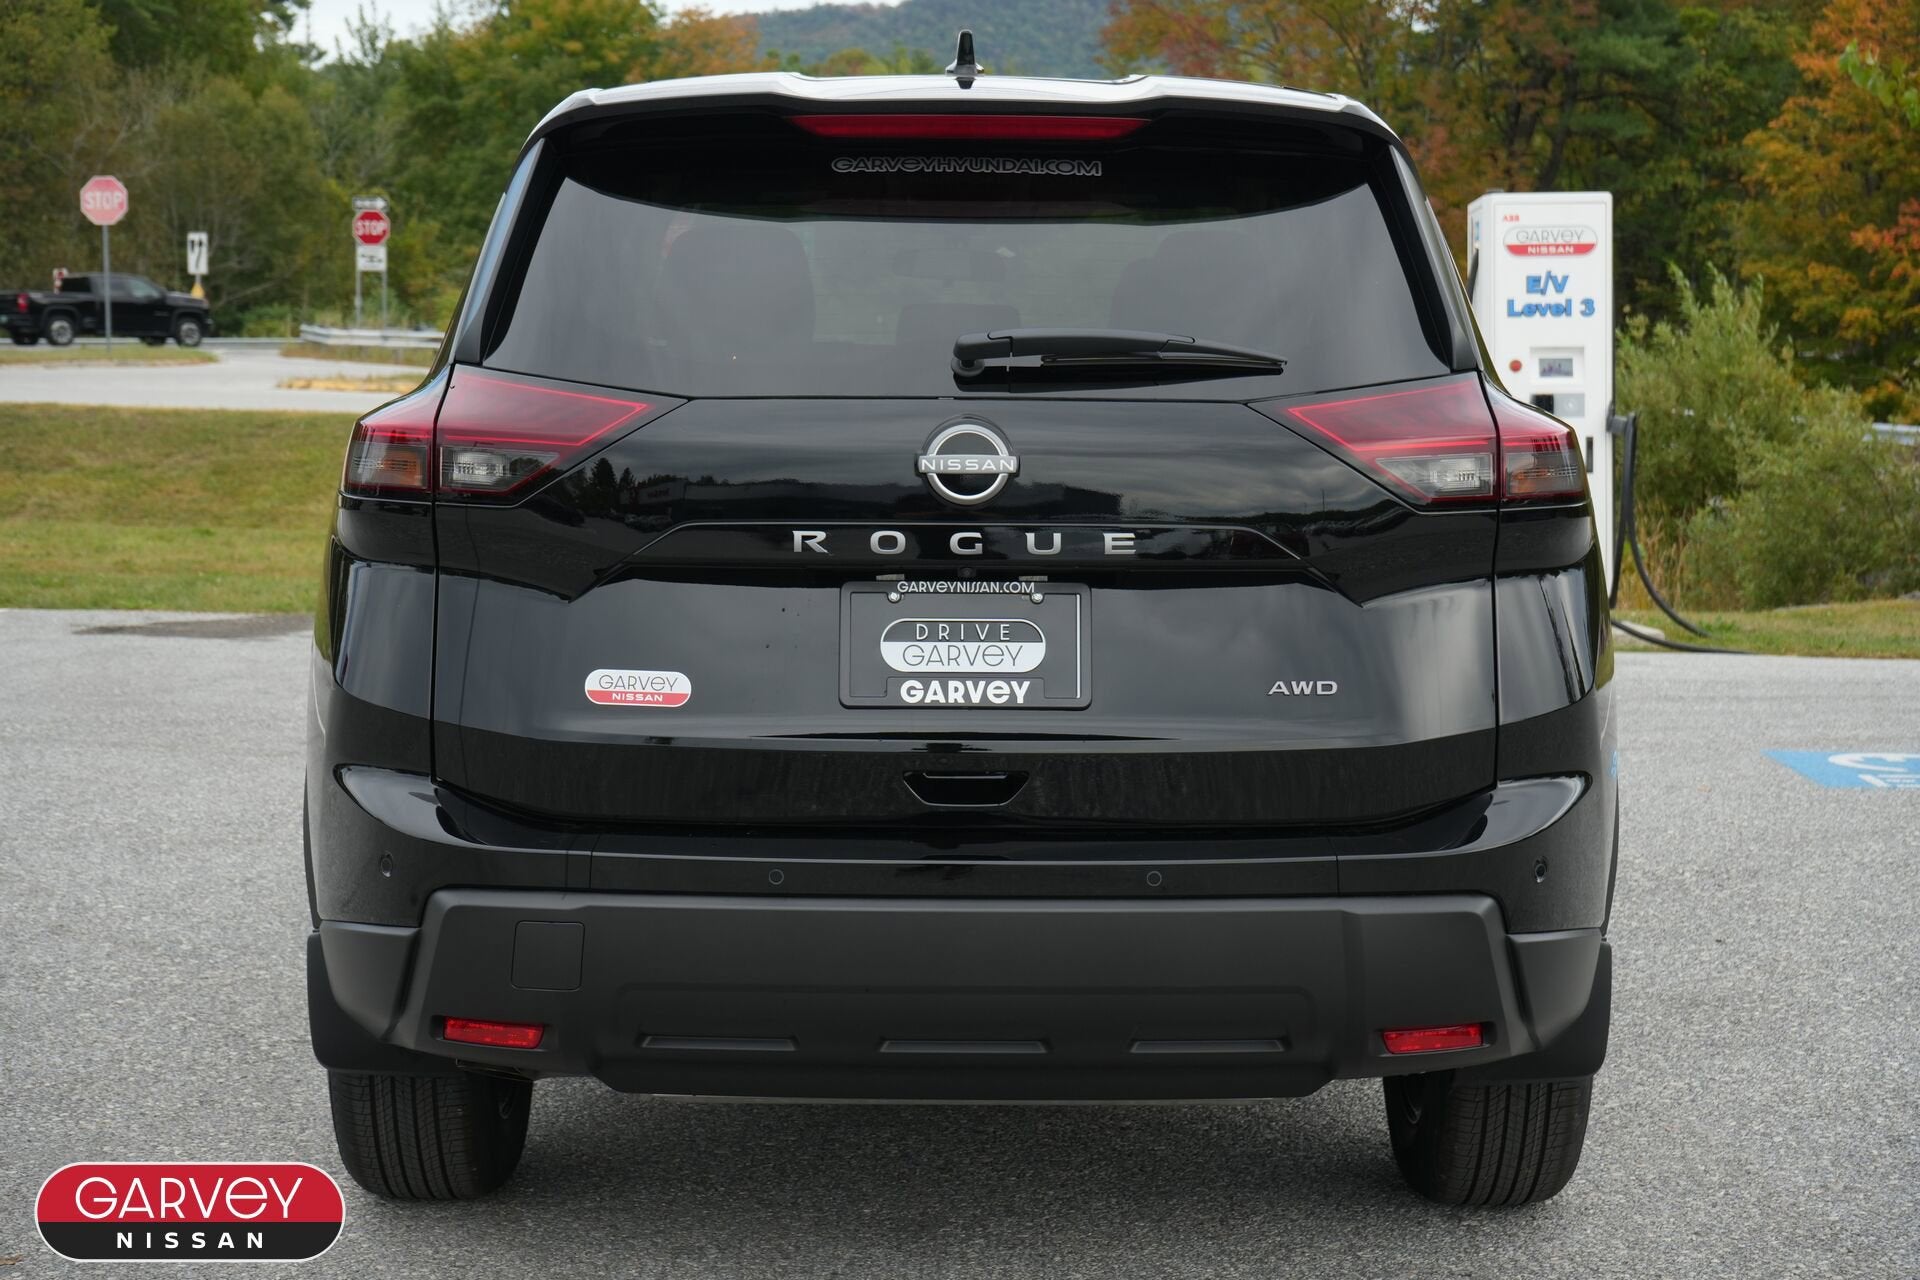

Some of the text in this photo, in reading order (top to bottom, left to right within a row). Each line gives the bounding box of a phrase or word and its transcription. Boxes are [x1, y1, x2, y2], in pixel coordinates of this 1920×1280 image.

[831, 157, 1102, 177] GARVEYHYUNDAI.COM
[84, 191, 124, 210] STOP
[355, 219, 388, 236] STOP
[1527, 246, 1574, 254] NISSAN
[1526, 270, 1569, 295] E/V
[1506, 298, 1596, 317] Level 3
[921, 458, 1016, 472] NISSAN
[792, 529, 1138, 556] ROGUE
[915, 623, 1010, 642] DRIVE
[612, 692, 663, 702] NISSAN
[1267, 680, 1339, 696] AWD
